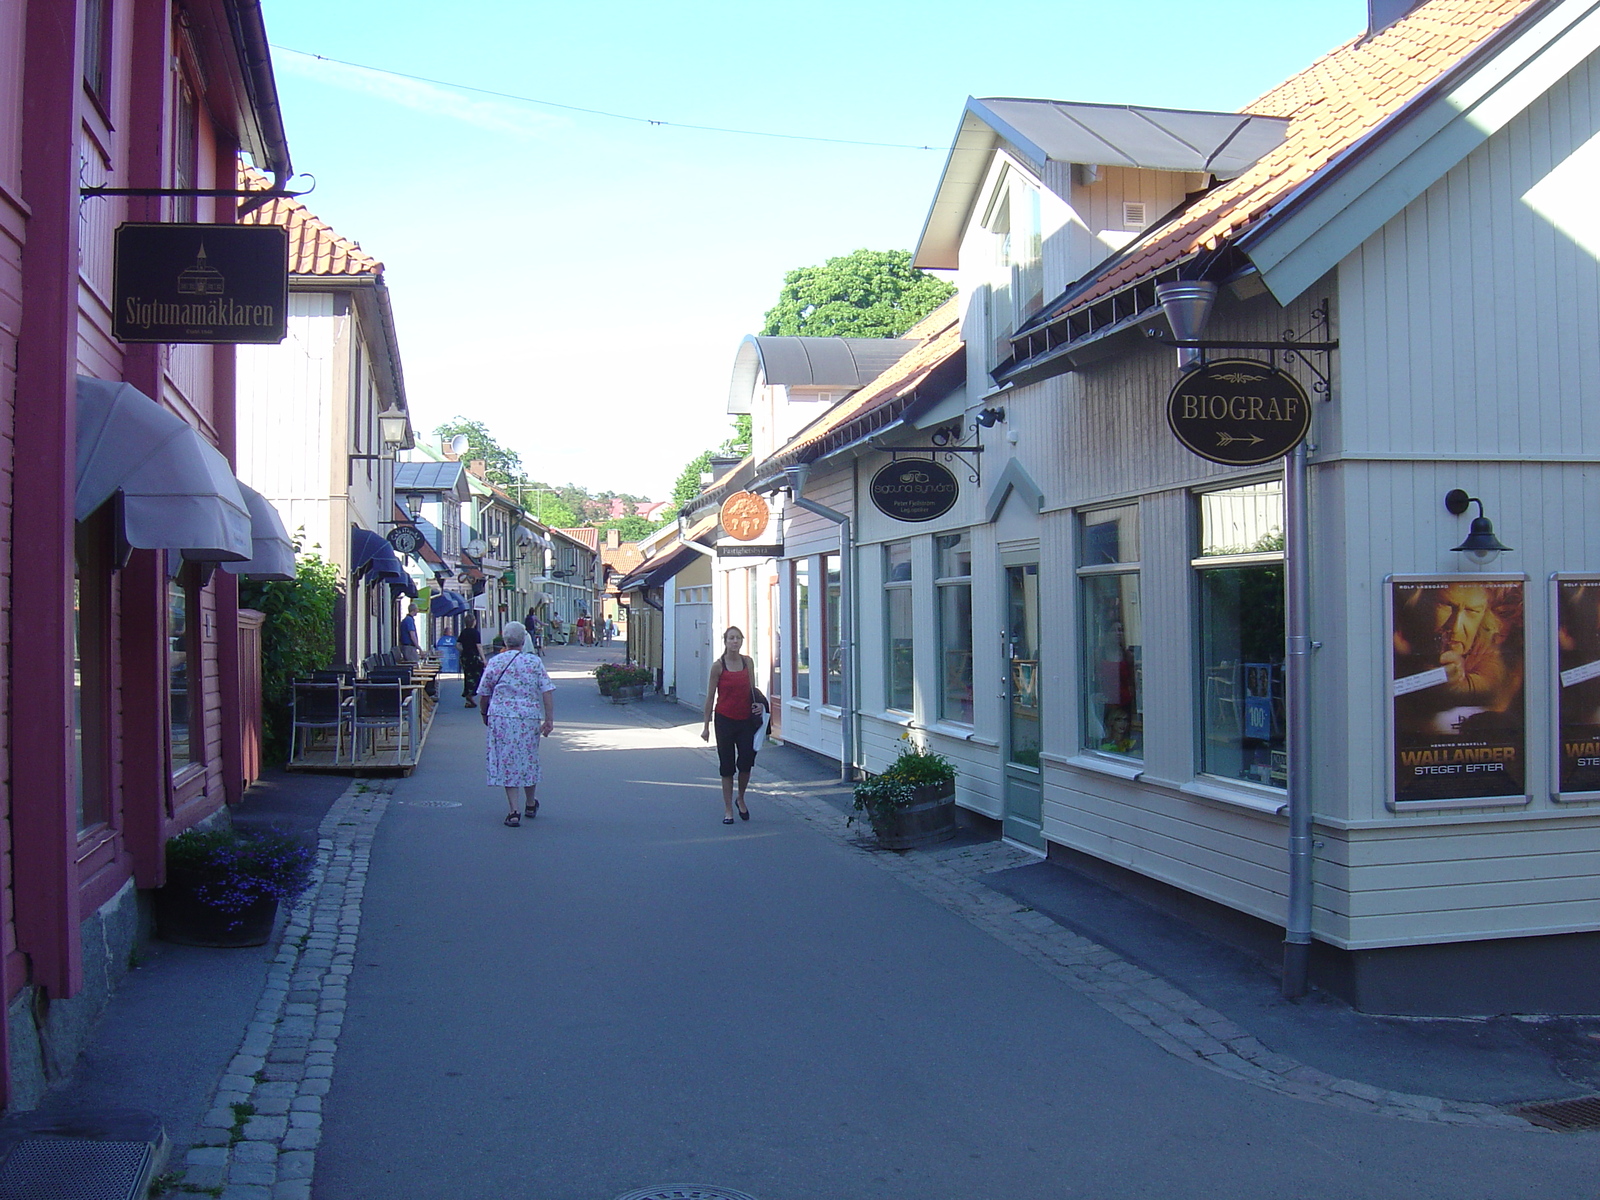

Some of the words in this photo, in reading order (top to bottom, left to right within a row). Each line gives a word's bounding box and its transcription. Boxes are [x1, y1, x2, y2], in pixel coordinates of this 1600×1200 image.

[126, 297, 273, 329] Sigtunamäklaren
[1181, 395, 1299, 422] BIOGRAF
[1401, 746, 1516, 766] WALLANDER
[1414, 764, 1463, 776] STEGET
[1465, 762, 1504, 773] EFTER
